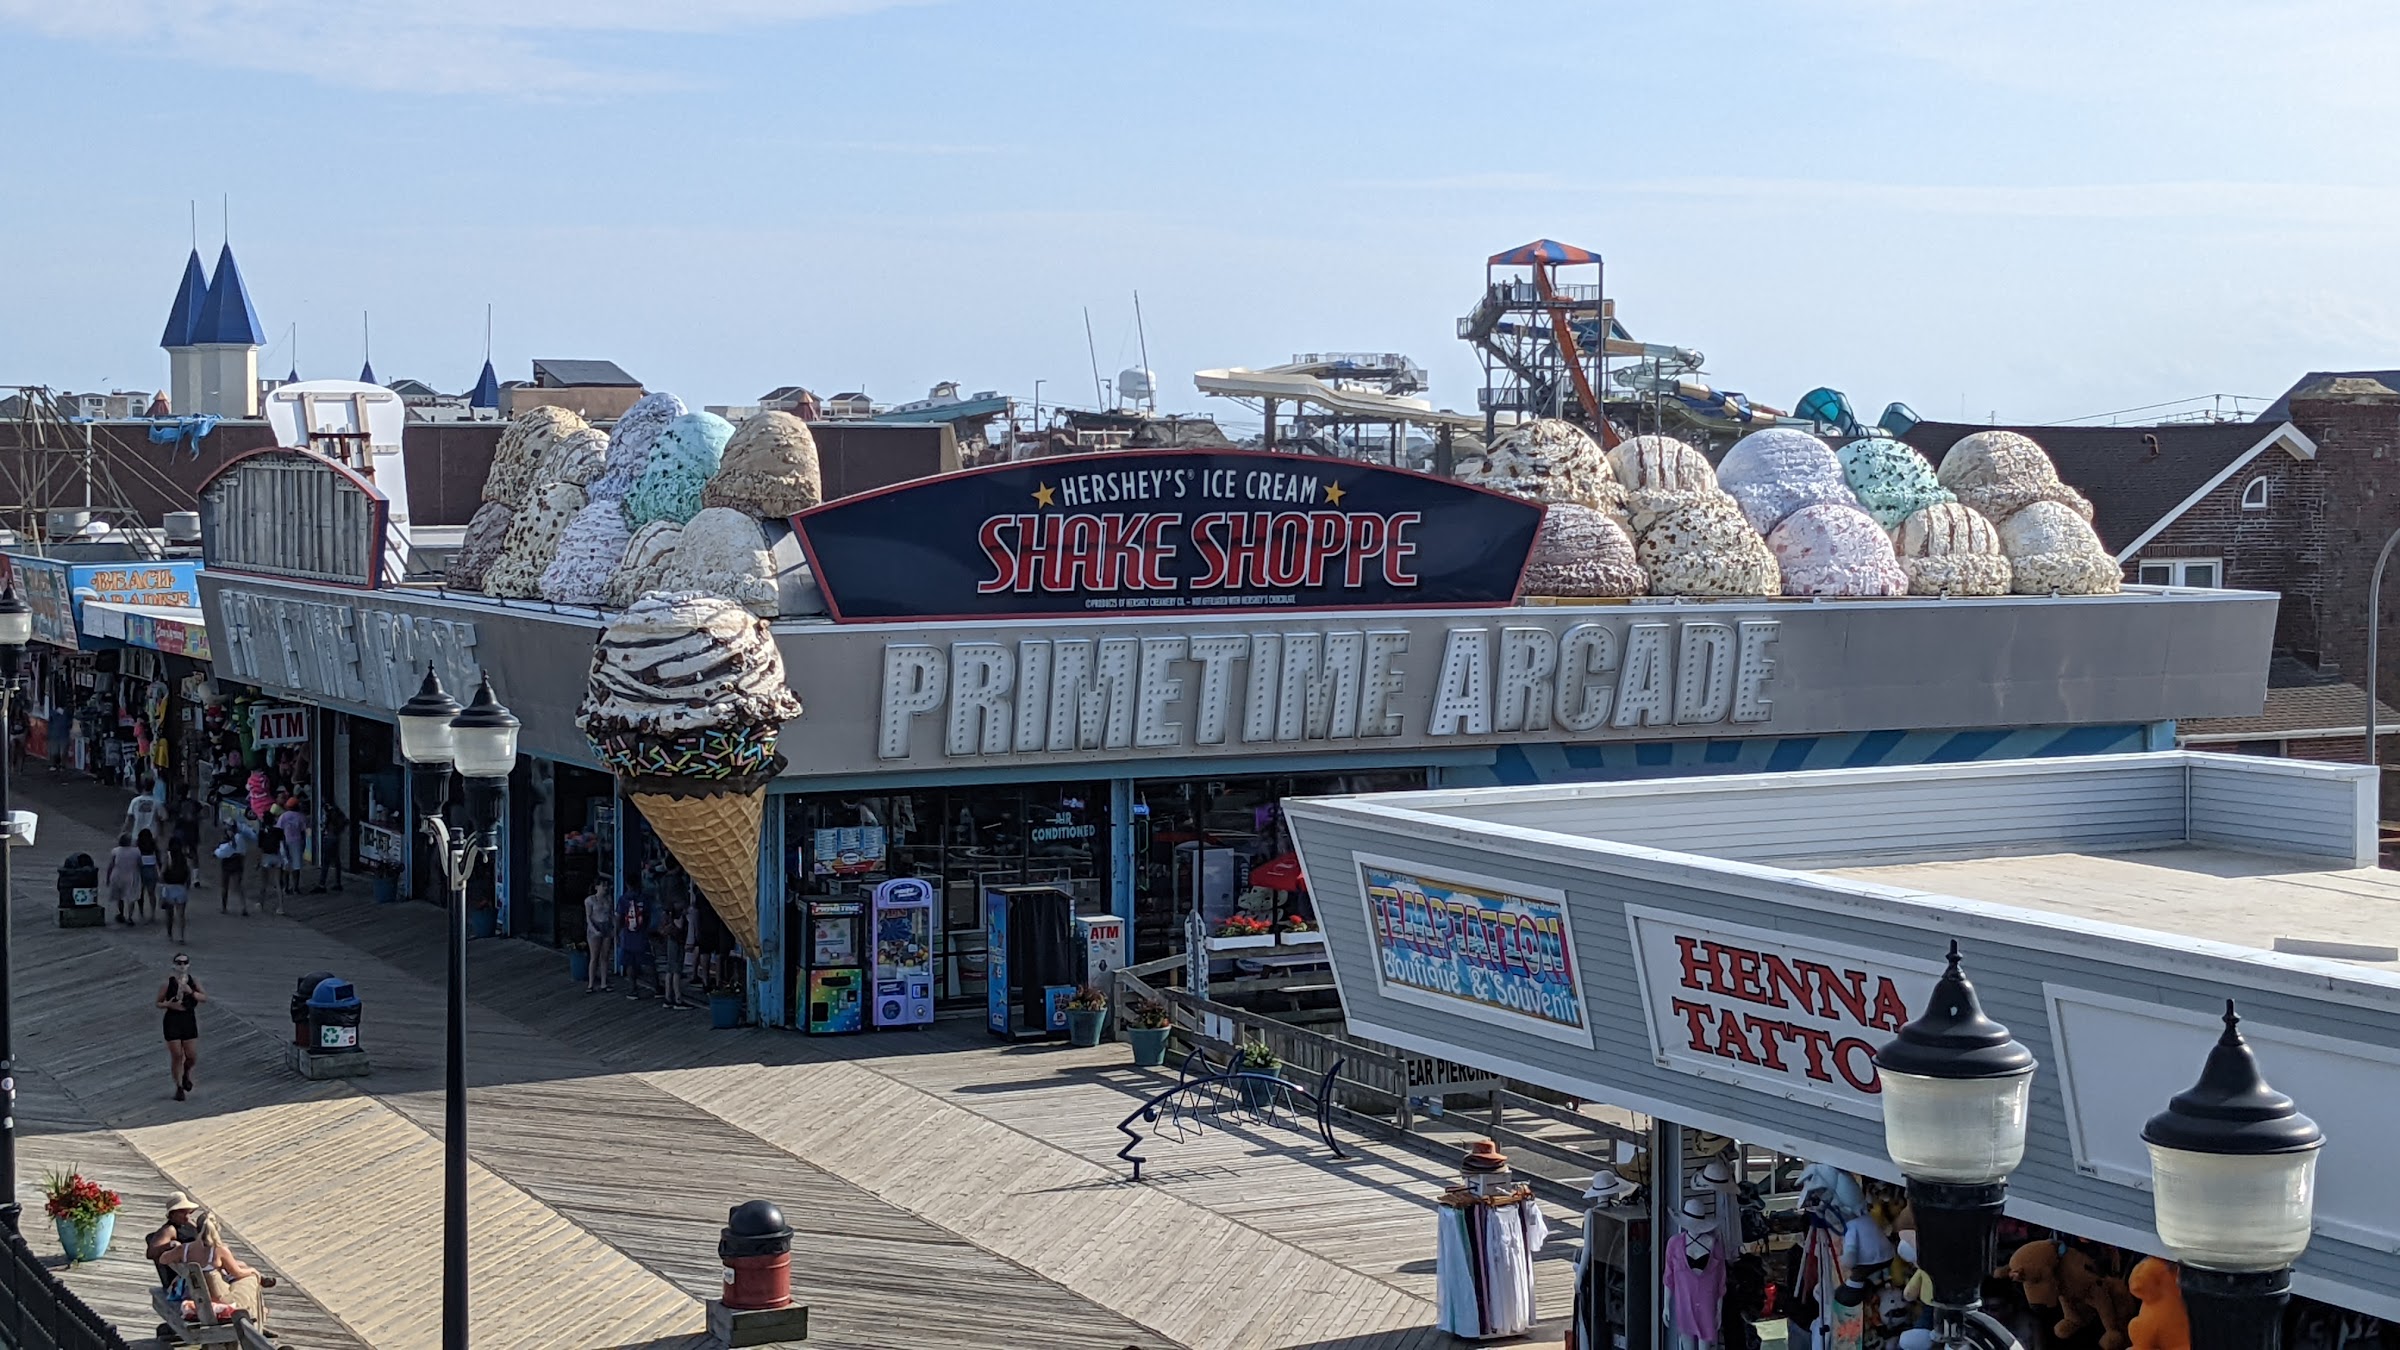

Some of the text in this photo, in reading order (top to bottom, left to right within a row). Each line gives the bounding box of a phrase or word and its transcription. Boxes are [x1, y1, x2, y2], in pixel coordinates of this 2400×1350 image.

[1202, 470, 1237, 498] ICE
[1245, 471, 1317, 504] CREAM
[977, 511, 1421, 593] SHAKE SHOPPE
[95, 569, 171, 590] BEACH
[878, 620, 1781, 760] PRIMETIME ARCADE
[259, 712, 304, 740] ATM
[1031, 825, 1096, 842] CONDITIONED
[1055, 812, 1071, 825] AIR
[1090, 926, 1119, 939] ATM
[1369, 886, 1568, 977] TEMPTATION
[1382, 949, 1580, 1025] Boutique & Souvenir
[1675, 935, 1908, 1034] HENNA
[1672, 996, 1882, 1094] TATTO
[1407, 1058, 1500, 1086] EAR PIERC
